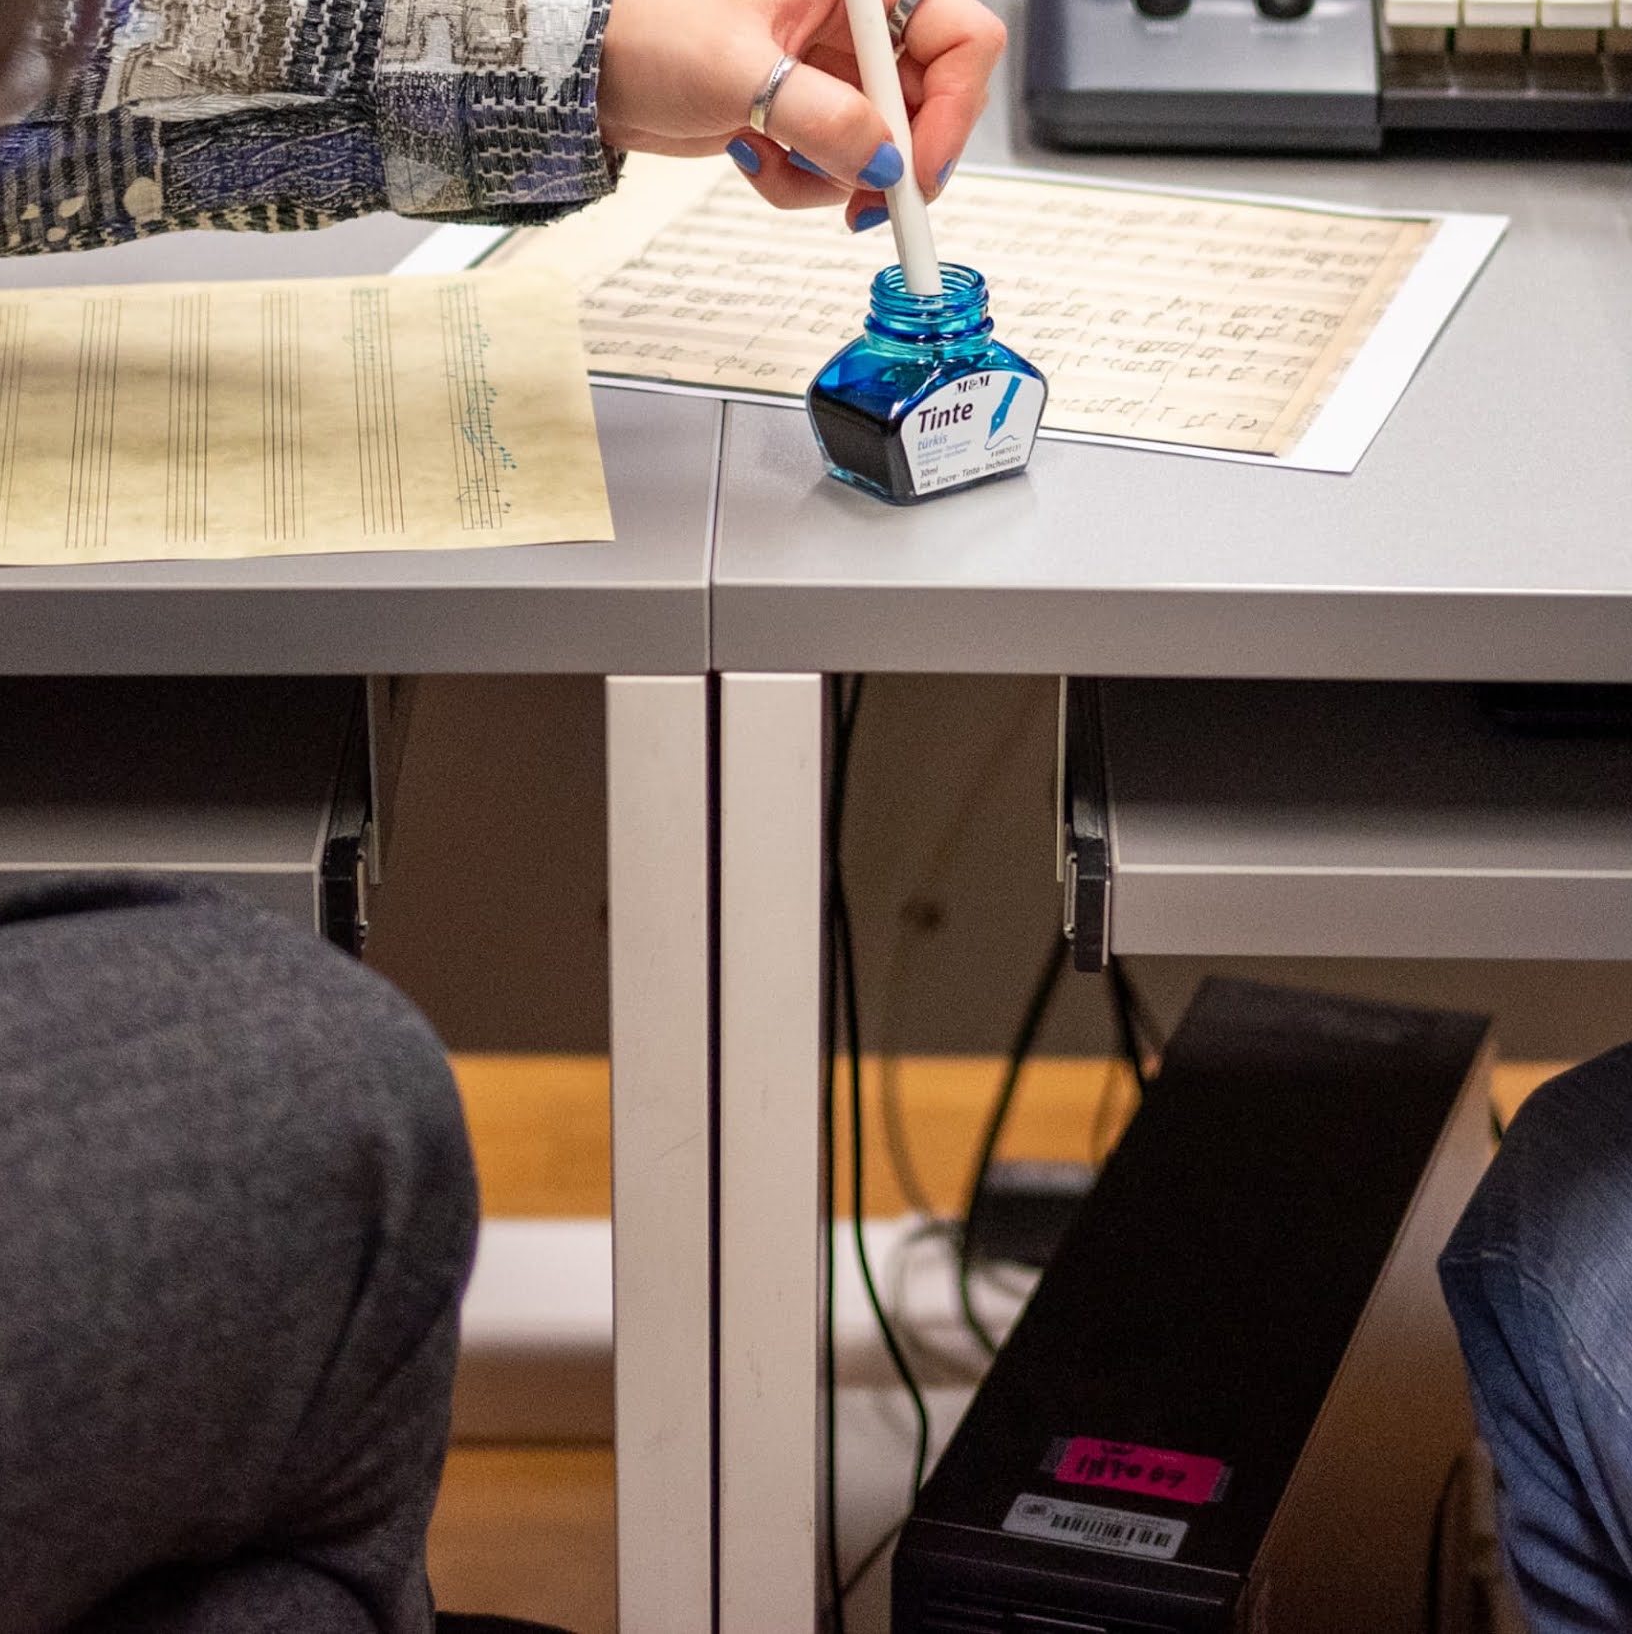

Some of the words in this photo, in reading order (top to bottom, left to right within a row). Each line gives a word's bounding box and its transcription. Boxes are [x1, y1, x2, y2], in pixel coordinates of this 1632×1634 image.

[954, 374, 991, 395] M&M
[918, 402, 973, 433] Tinte
[917, 433, 948, 451] türkis
[936, 474, 956, 486] Encre
